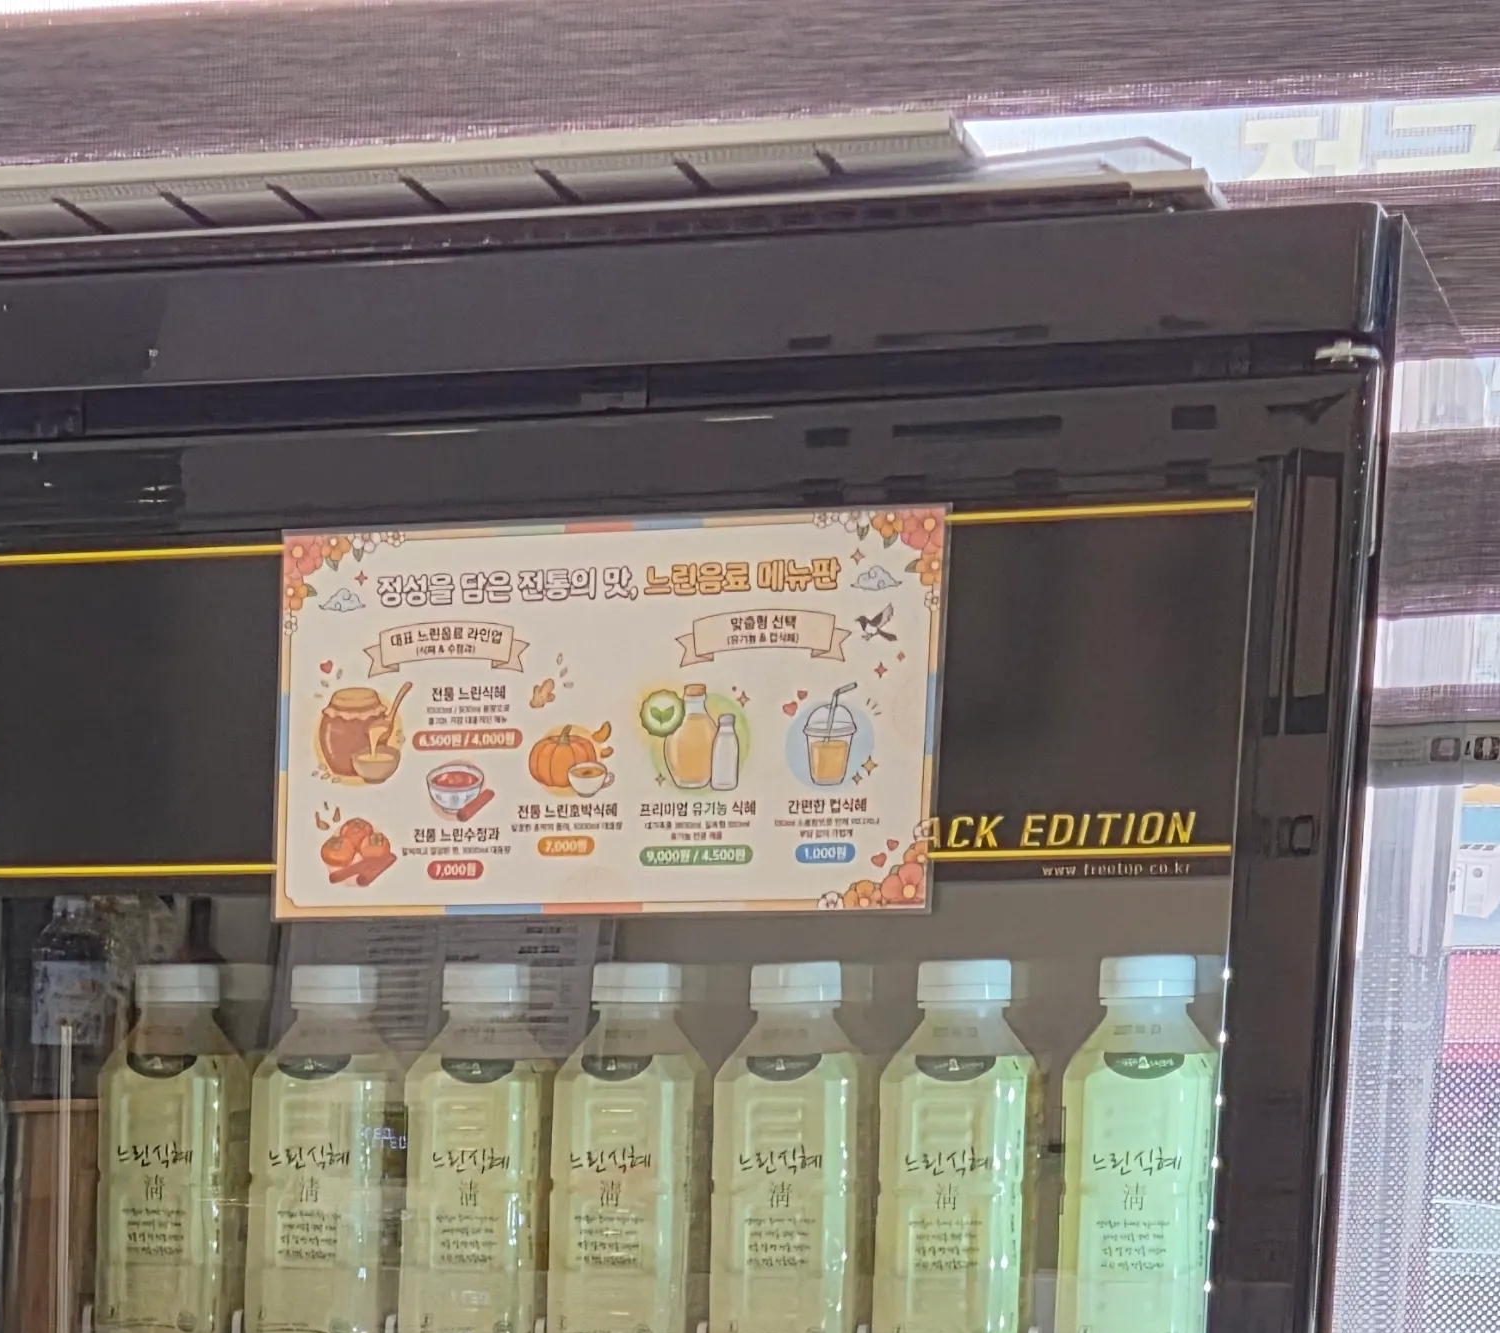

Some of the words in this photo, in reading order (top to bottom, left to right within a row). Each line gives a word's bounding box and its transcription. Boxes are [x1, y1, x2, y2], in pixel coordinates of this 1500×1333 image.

[376, 573, 455, 608] 정성을
[460, 570, 513, 605] 담은
[517, 566, 597, 603] 전통의
[603, 564, 638, 600] 맛,
[643, 561, 751, 597] 느린음료
[757, 556, 842, 593] 메뉴판
[730, 614, 768, 631] 맞춤형
[772, 614, 797, 630] 선택
[390, 630, 414, 647] 대표
[467, 626, 503, 645] 라인업
[431, 685, 455, 702] 전통
[458, 685, 507, 701] 느린식혜
[470, 731, 515, 746] 4,000원
[639, 802, 688, 817] 프리미엄
[692, 801, 728, 816] 유기농
[732, 800, 756, 816] 식혜
[788, 798, 826, 815] 간편한
[829, 797, 867, 813] 컵식혜
[439, 827, 500, 842] 느린수정과
[922, 815, 1004, 848] ACK
[1019, 811, 1197, 848] EDITION
[646, 850, 690, 864] 9,000원
[702, 848, 746, 862] 4,500원
[117, 1144, 193, 1167] 느린식혜
[268, 1143, 351, 1169] 느린식혜
[431, 1146, 511, 1173] 느린식혜
[569, 1144, 652, 1174] 느린식혜
[738, 1143, 823, 1176] 느린식혜
[904, 1147, 995, 1177] 느린식혜
[1092, 1146, 1183, 1176] 느린식혜
